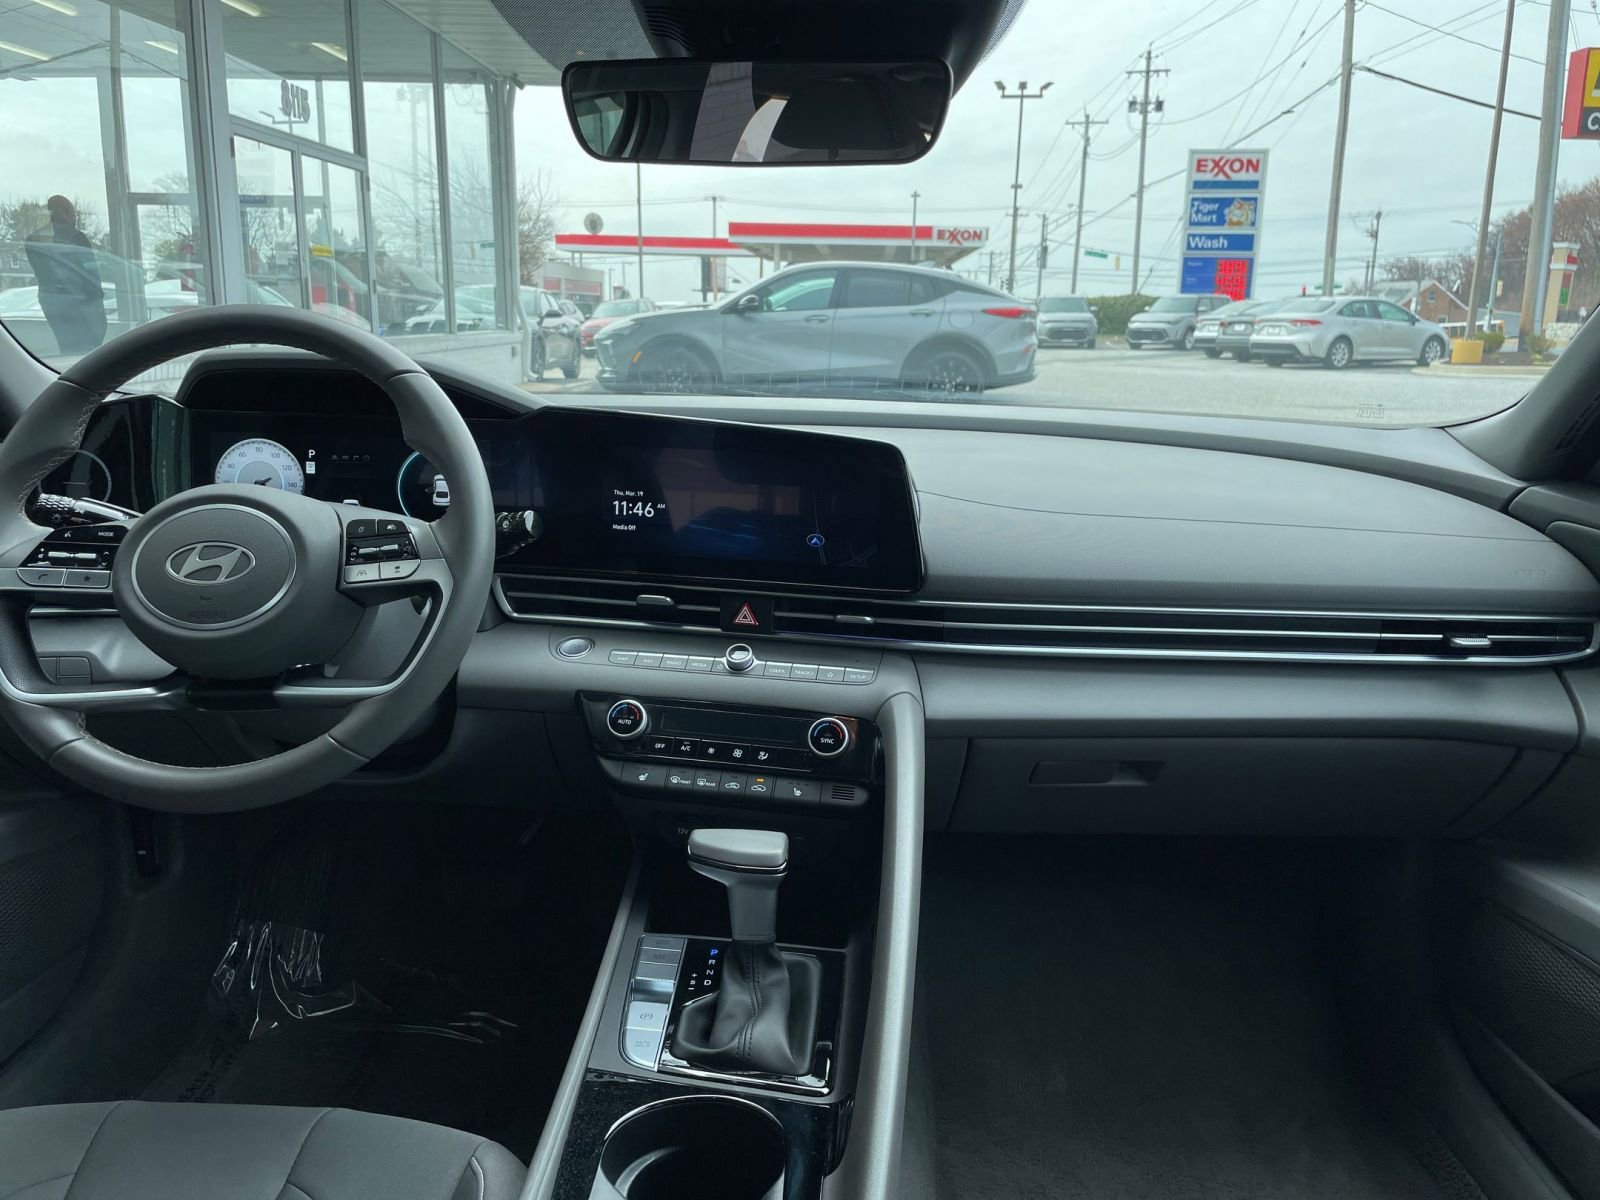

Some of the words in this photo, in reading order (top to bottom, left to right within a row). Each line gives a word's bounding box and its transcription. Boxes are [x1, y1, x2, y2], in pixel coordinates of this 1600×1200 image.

[1195, 156, 1260, 180] EXXON
[1191, 201, 1219, 214] Tiger
[1190, 213, 1217, 223] Mart
[937, 227, 983, 245] EXXON
[1189, 236, 1228, 249] Wash
[308, 449, 316, 459] P
[613, 500, 655, 518] 11:46
[98, 531, 115, 539] MODE
[680, 744, 691, 752] A/C
